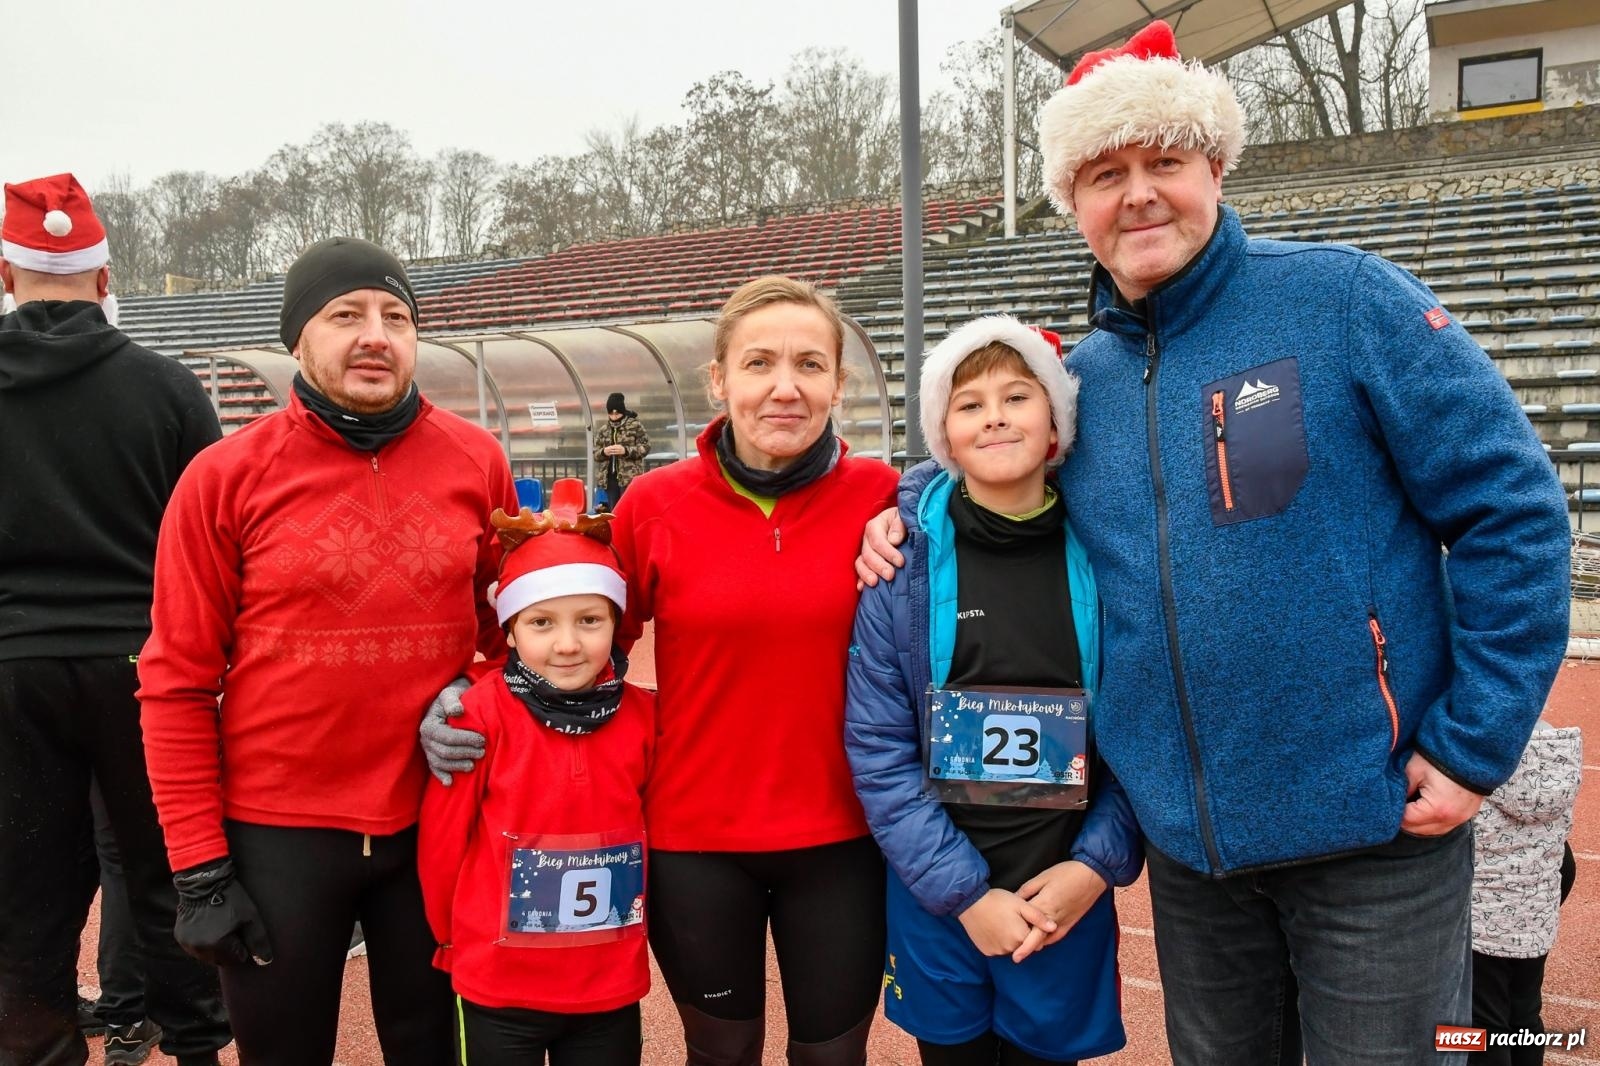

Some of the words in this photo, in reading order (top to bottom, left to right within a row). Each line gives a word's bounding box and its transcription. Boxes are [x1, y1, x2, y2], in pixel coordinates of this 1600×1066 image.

[957, 609, 985, 619] KIPSTA
[957, 696, 984, 713] Bieg
[988, 699, 1064, 716] Mikołajkowy
[982, 726, 1039, 767] 23
[537, 853, 564, 870] Bieg
[567, 852, 628, 868] Mikołajkowy
[573, 880, 598, 917] 5
